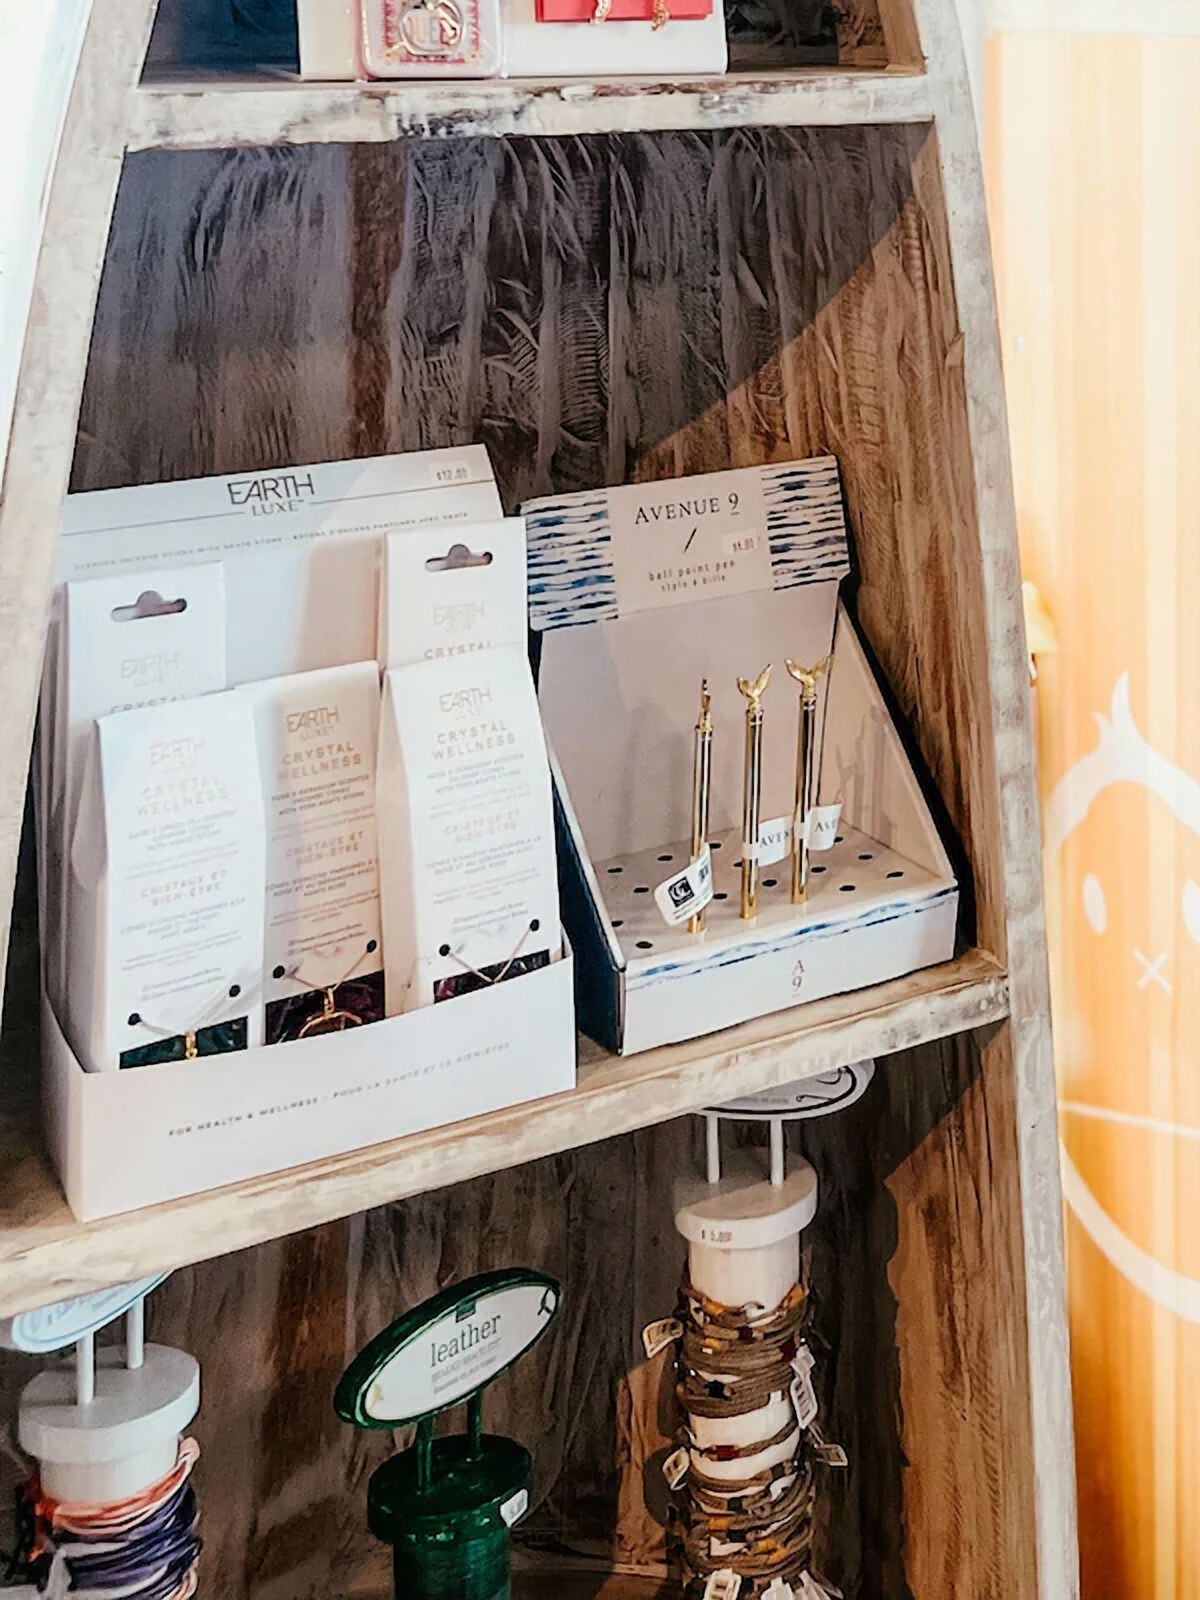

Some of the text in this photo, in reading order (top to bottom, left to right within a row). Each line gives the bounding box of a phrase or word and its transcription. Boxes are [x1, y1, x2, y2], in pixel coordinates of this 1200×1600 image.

[227, 473, 314, 505] EARTH
[252, 502, 299, 517] LUXE
[634, 492, 739, 525] AVENUE 9
[439, 685, 493, 713] EARTH
[286, 704, 340, 733] EARTH
[437, 720, 508, 745] CRYSTAL
[281, 741, 355, 765] CRYSTAL
[432, 732, 516, 760] WELLNESS
[277, 753, 362, 780] WELLNESS
[791, 959, 805, 975] A
[791, 976, 803, 993] 9
[168, 1125, 192, 1137] FOR
[197, 1114, 242, 1130] HEALTH
[258, 1097, 318, 1116] WELLNESS
[430, 1314, 502, 1367] leather
